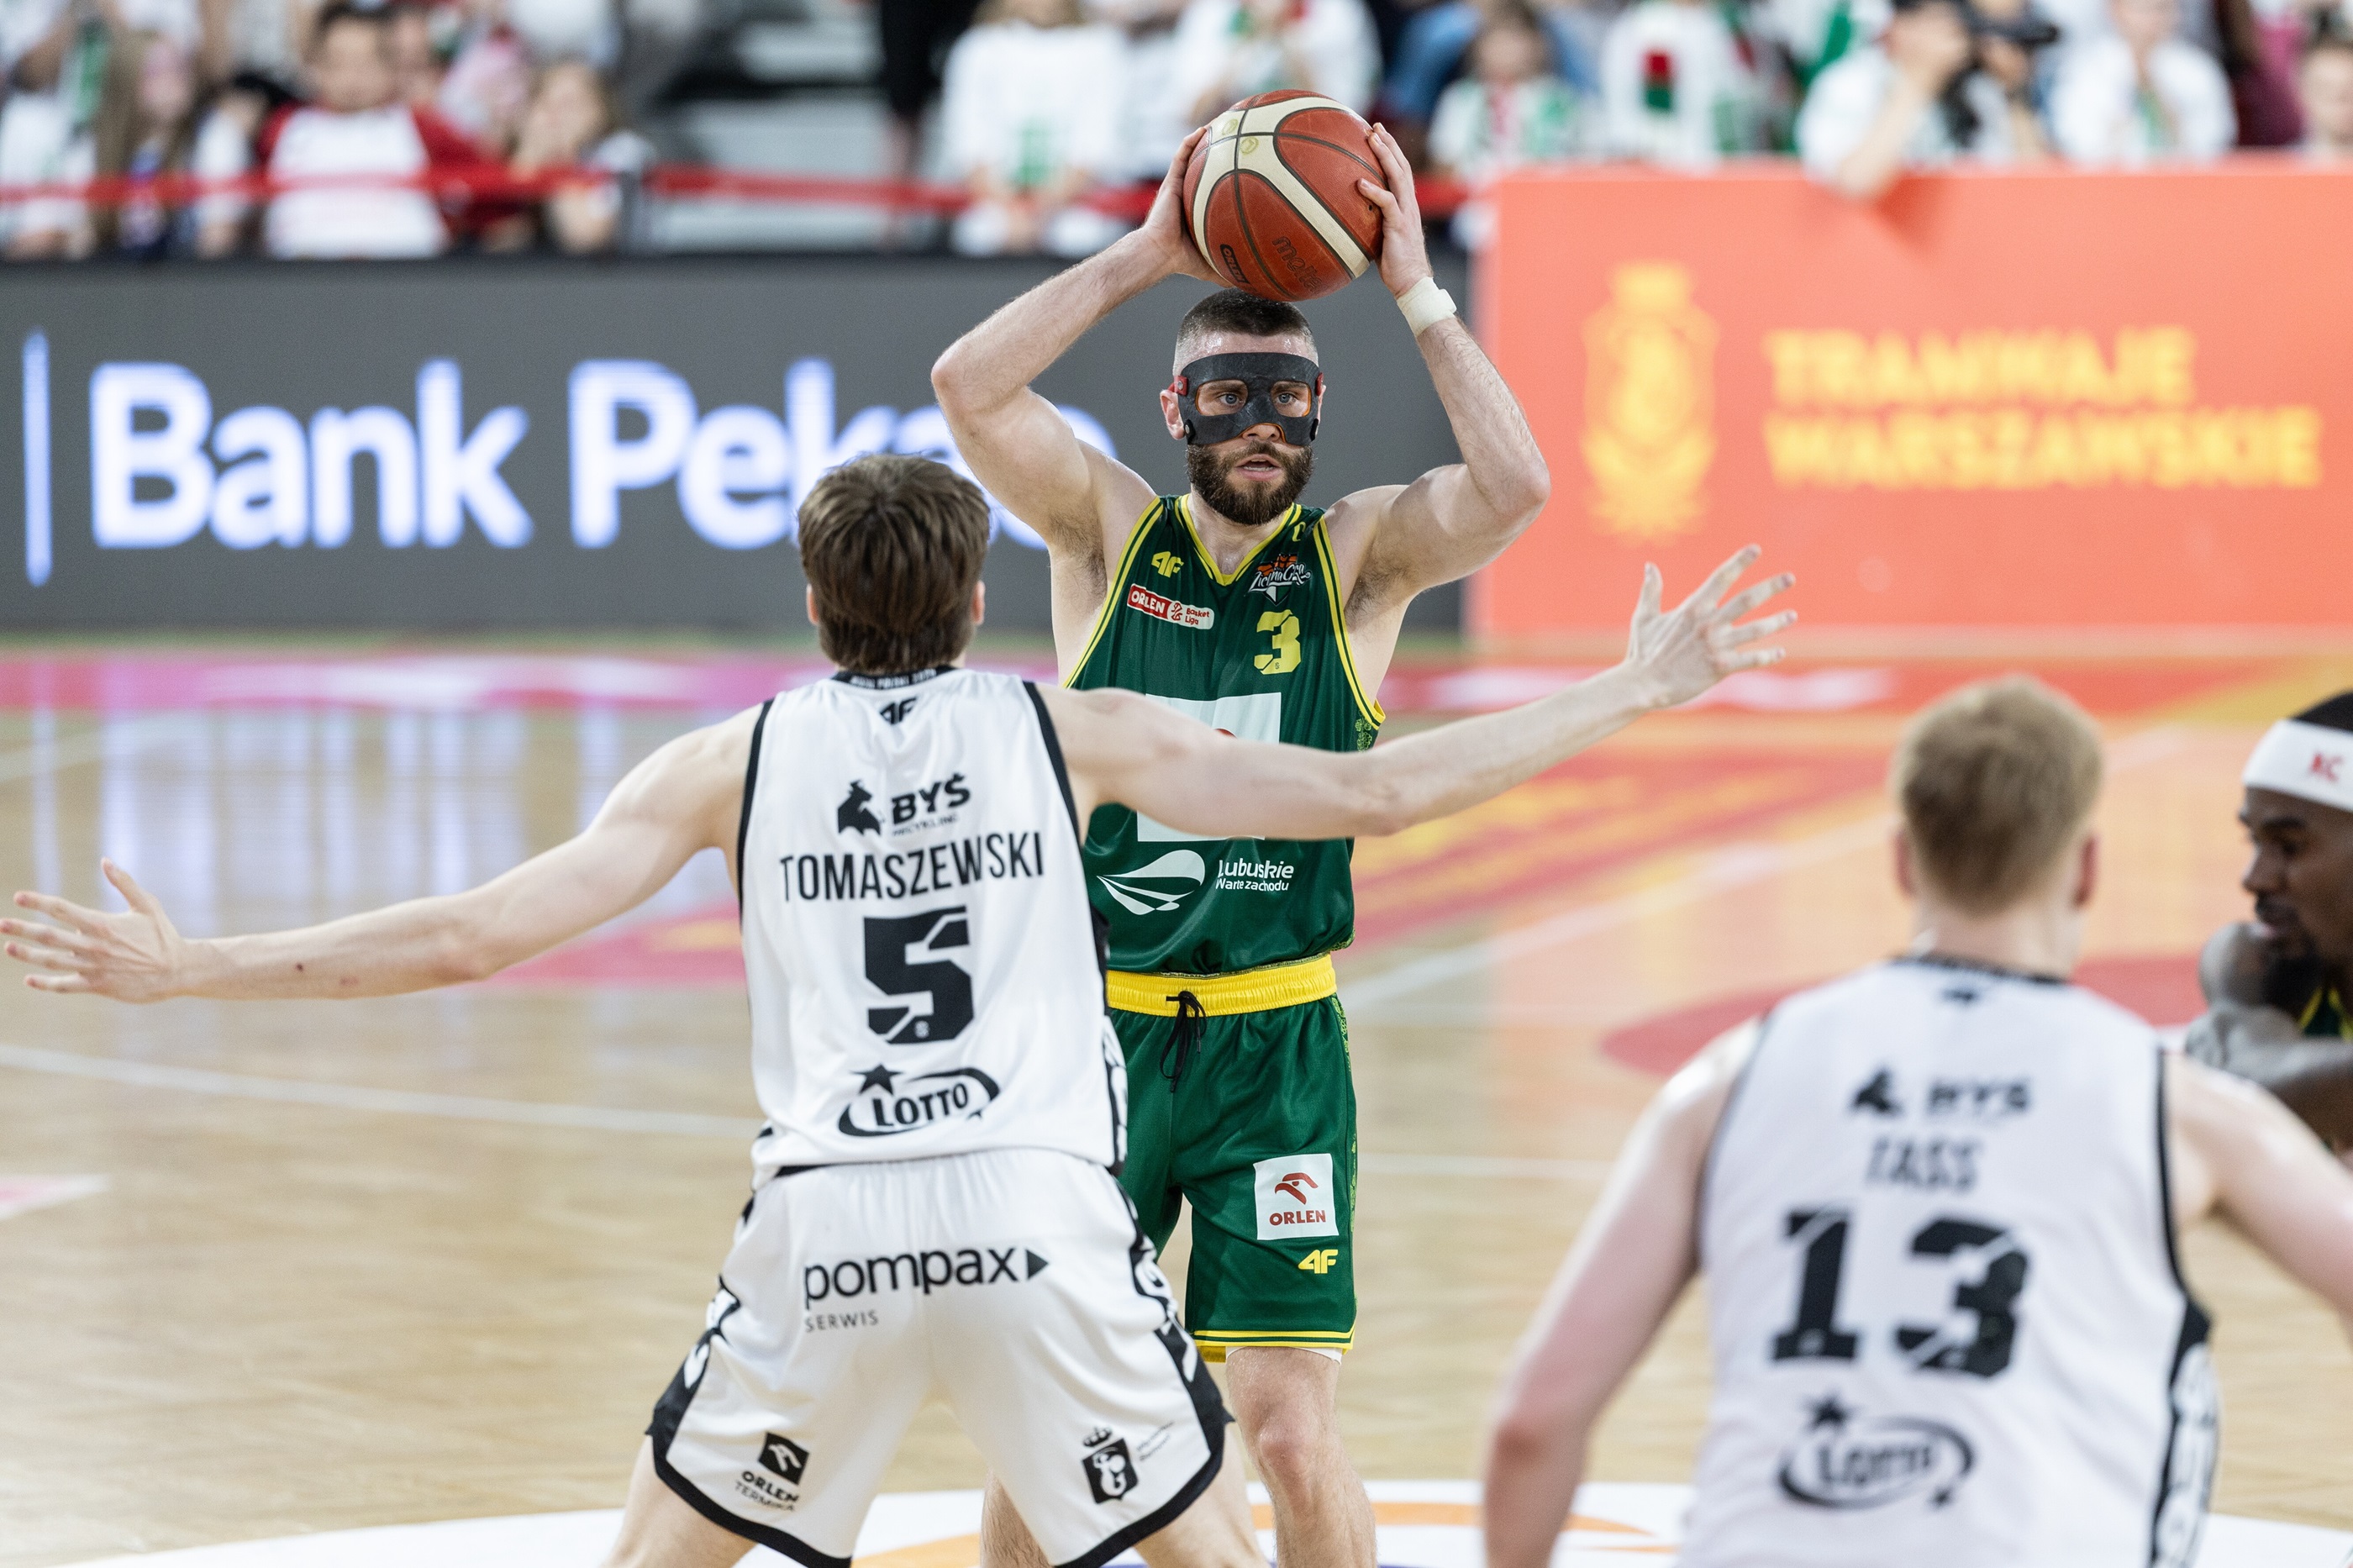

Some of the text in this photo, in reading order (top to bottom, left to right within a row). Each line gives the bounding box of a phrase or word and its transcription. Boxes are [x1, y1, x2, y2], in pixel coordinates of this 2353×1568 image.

[90, 356, 1118, 550] Bank Pek
[1131, 590, 1166, 614] ORLEN
[1186, 608, 1210, 618] Basket
[1185, 615, 1199, 625] Liga
[1254, 609, 1301, 675] 3
[780, 832, 1045, 902] TOMASZEWSKI
[1218, 858, 1294, 879] Lubuskie
[1215, 877, 1290, 892] Warte zachodu
[863, 905, 975, 1044] 5
[872, 1082, 970, 1129] LOTTO
[1269, 1210, 1326, 1226] ORLEN
[1298, 1250, 1339, 1274] 4F
[804, 1248, 1019, 1311] pompax
[1771, 1205, 2029, 1380] 13
[805, 1310, 880, 1334] SERWIS
[741, 1471, 799, 1502] ORLEN
